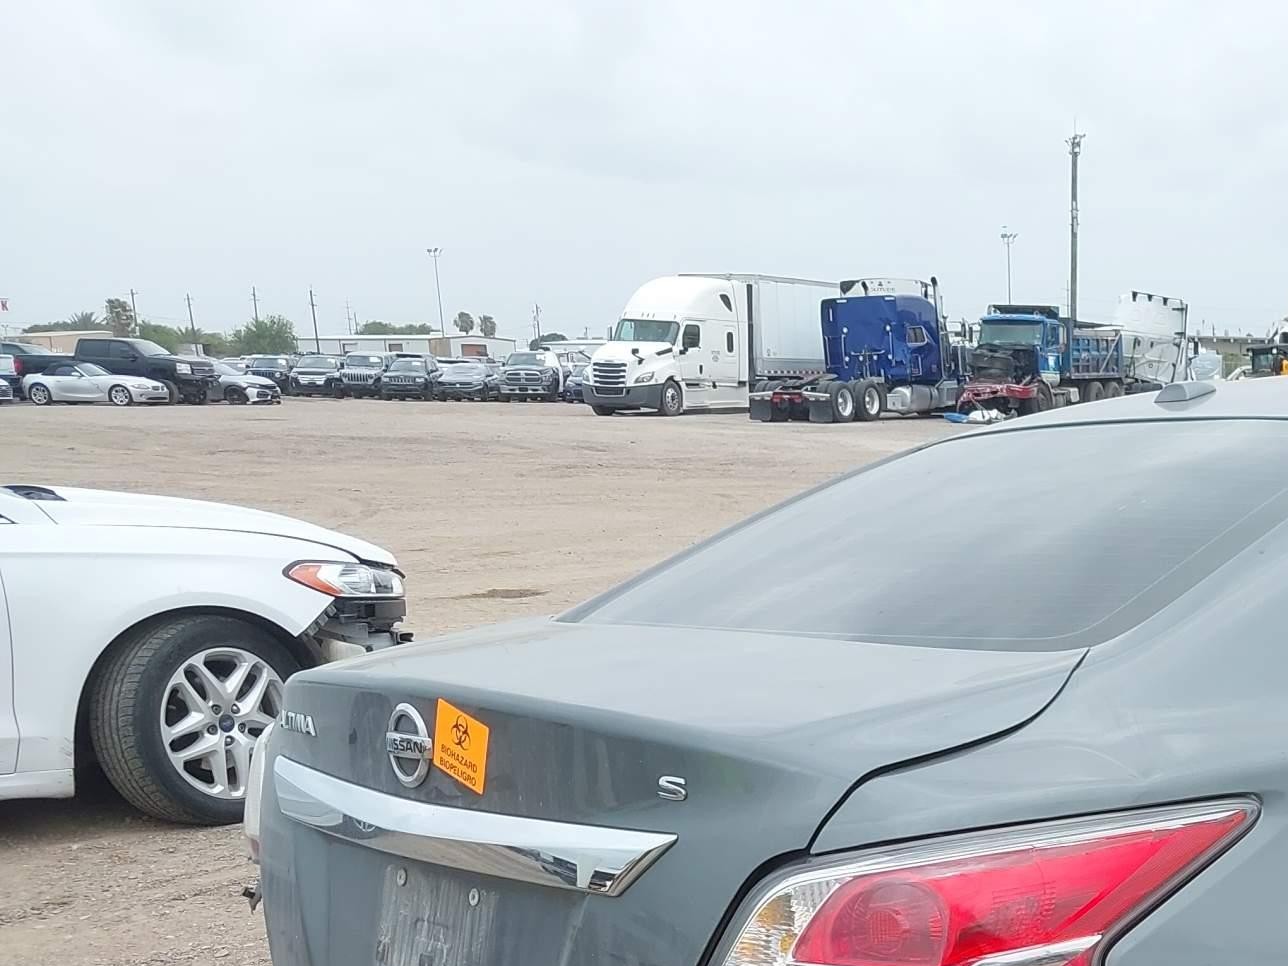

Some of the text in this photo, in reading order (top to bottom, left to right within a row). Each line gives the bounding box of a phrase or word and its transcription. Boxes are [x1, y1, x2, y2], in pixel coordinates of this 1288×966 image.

[386, 737, 423, 754] NISSAN
[440, 743, 478, 774] BIOHAZARD
[439, 756, 477, 787] BIOPELIGRO
[657, 775, 687, 801] S
